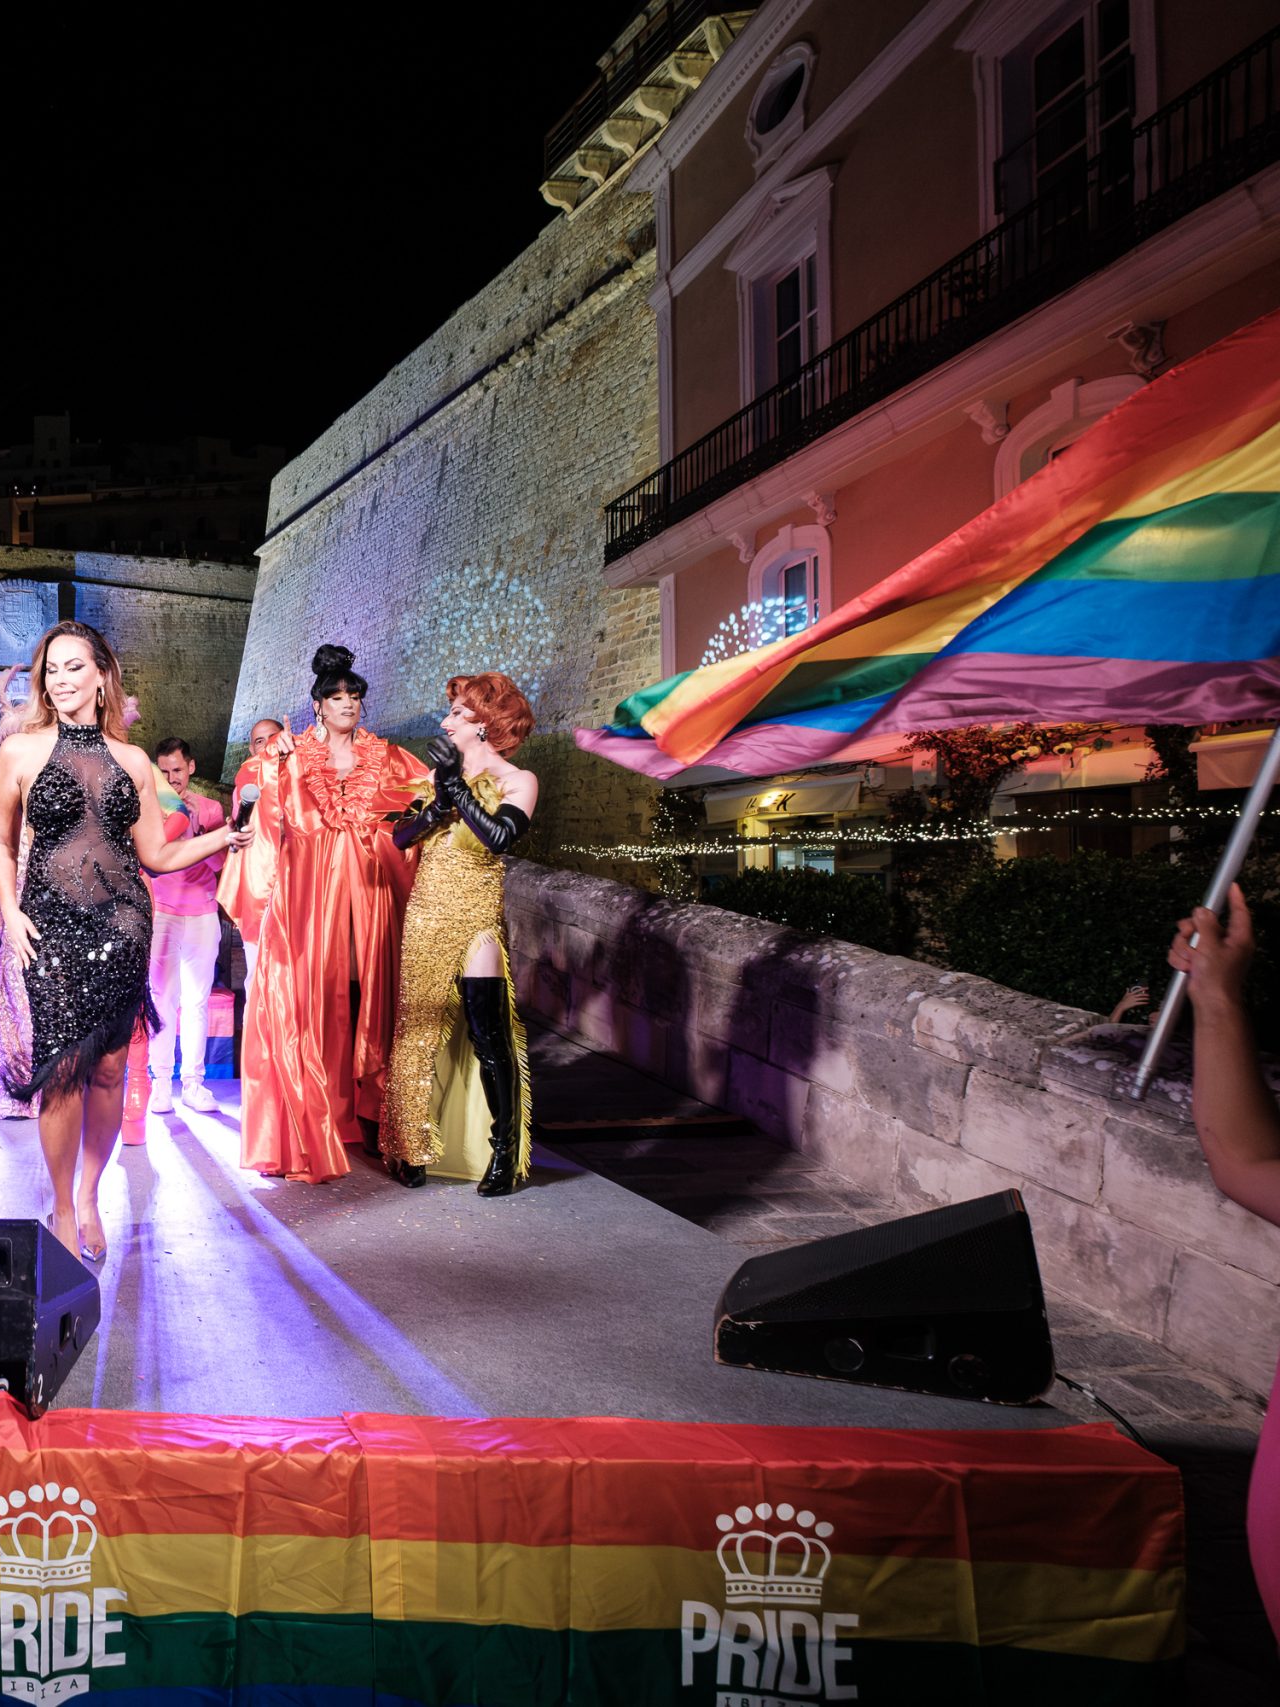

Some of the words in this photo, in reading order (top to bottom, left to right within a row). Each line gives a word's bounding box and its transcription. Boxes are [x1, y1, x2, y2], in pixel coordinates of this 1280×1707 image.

[681, 1600, 860, 1700] PRIDE
[10, 1678, 79, 1700] IBIZA
[724, 1696, 807, 1707] IBIZ
